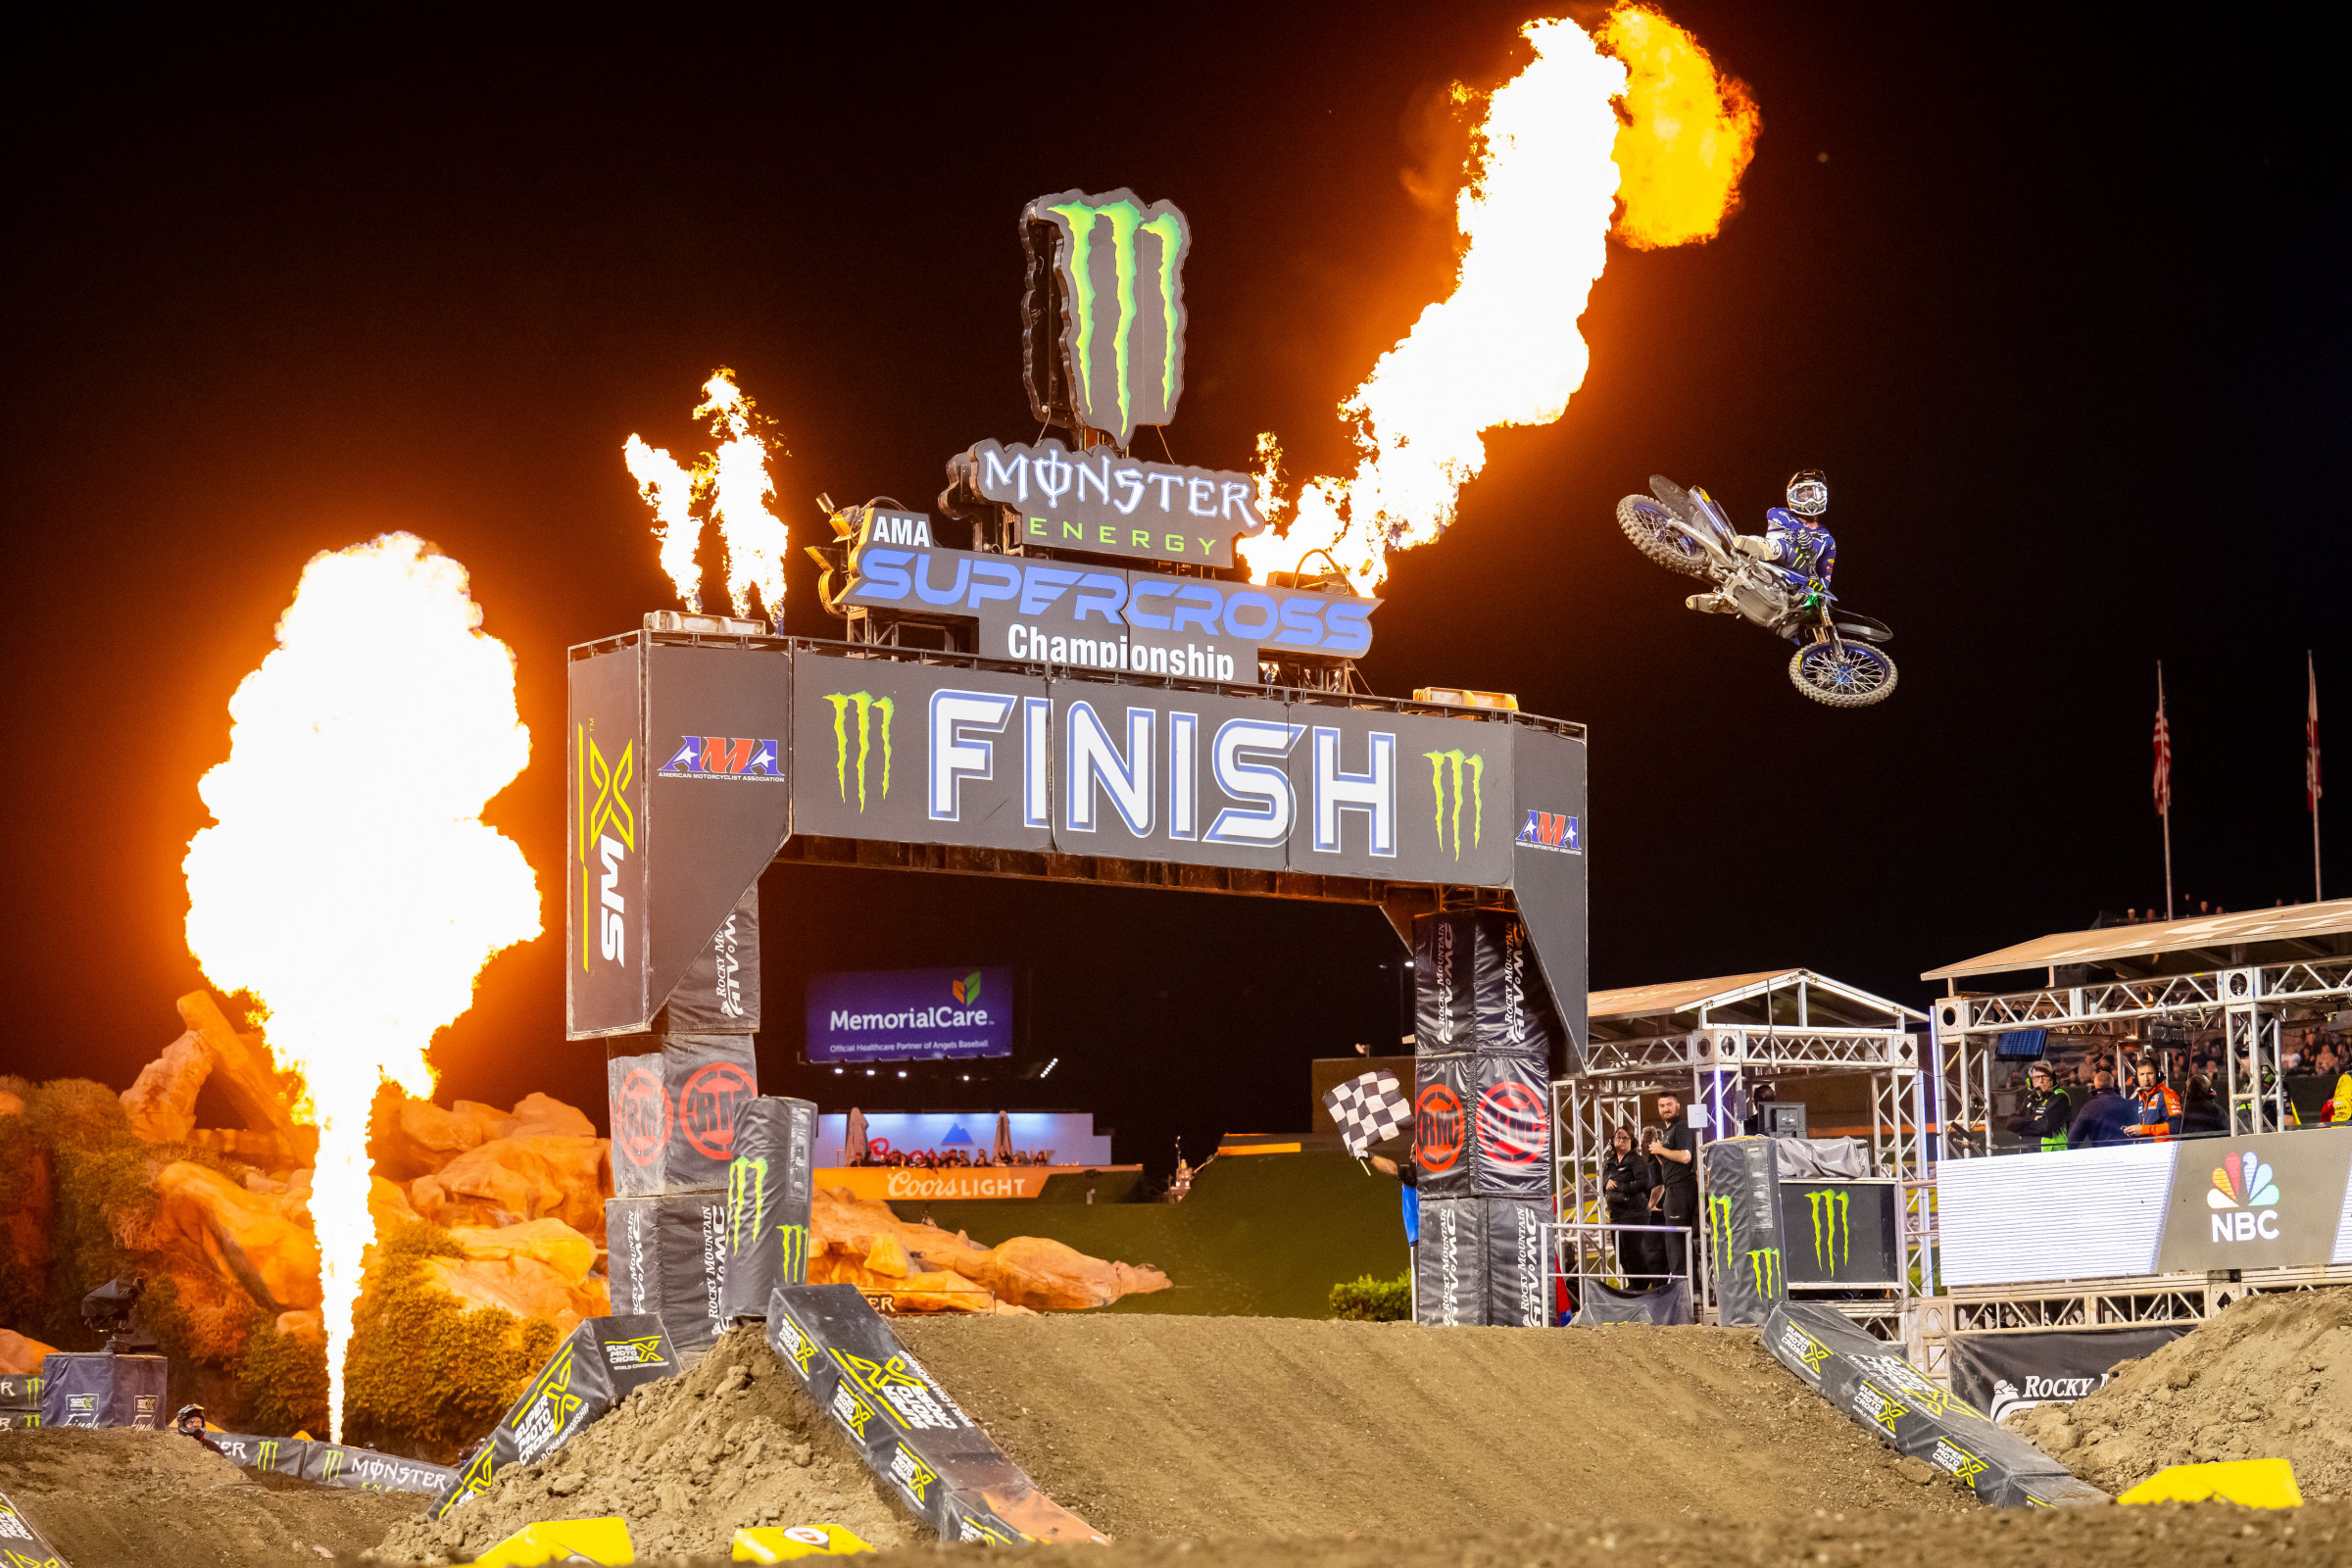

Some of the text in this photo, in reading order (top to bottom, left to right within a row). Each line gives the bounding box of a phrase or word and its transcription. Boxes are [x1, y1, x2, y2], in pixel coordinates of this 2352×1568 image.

[983, 449, 1260, 528] MONSTER
[873, 515, 931, 548] AMA
[1029, 517, 1217, 556] ENERGY
[855, 551, 1381, 652] SUPERCROSS
[1006, 622, 1235, 681] Championship
[657, 735, 786, 776] AMA
[927, 688, 1397, 858] FINISH
[742, 774, 785, 783] ASSOCIATION
[1514, 808, 1583, 850] AMA
[1437, 922, 1446, 986] MOUNTAIN
[1504, 921, 1514, 1024] ROCKY MOUNTAIN
[715, 955, 727, 999] ROCKY
[829, 1005, 989, 1031] MemorialCare
[829, 1039, 989, 1054] Official Healthcare Partner of Angels Baseball
[887, 1170, 1026, 1198] Coors LIGHT
[2211, 1208, 2280, 1243] NBC
[701, 1205, 719, 1320] ROCKY MOUNTAIN
[1440, 1207, 1450, 1311] ROCKY MOUNTAIN
[1516, 1206, 1529, 1313] ROCKY MOUNTAIN
[1781, 1337, 1806, 1357] CROSS
[1786, 1332, 1808, 1352] MOTO
[1787, 1325, 1811, 1348] SUPER
[1857, 1391, 1883, 1410] MOTO
[1859, 1384, 1886, 1406] SUPER
[2022, 1375, 2095, 1398] ROCKY
[514, 1394, 549, 1445] SUPER
[1853, 1396, 1881, 1416] CROSS
[518, 1407, 552, 1453] MOTO
[518, 1418, 557, 1466] CROSS
[545, 1401, 590, 1457] CHAMPIONSHIP
[1932, 1452, 1959, 1472] CROSS
[1936, 1440, 1965, 1462] SUPER
[1936, 1447, 1960, 1467] MOTO
[351, 1456, 448, 1491] MONSTER
